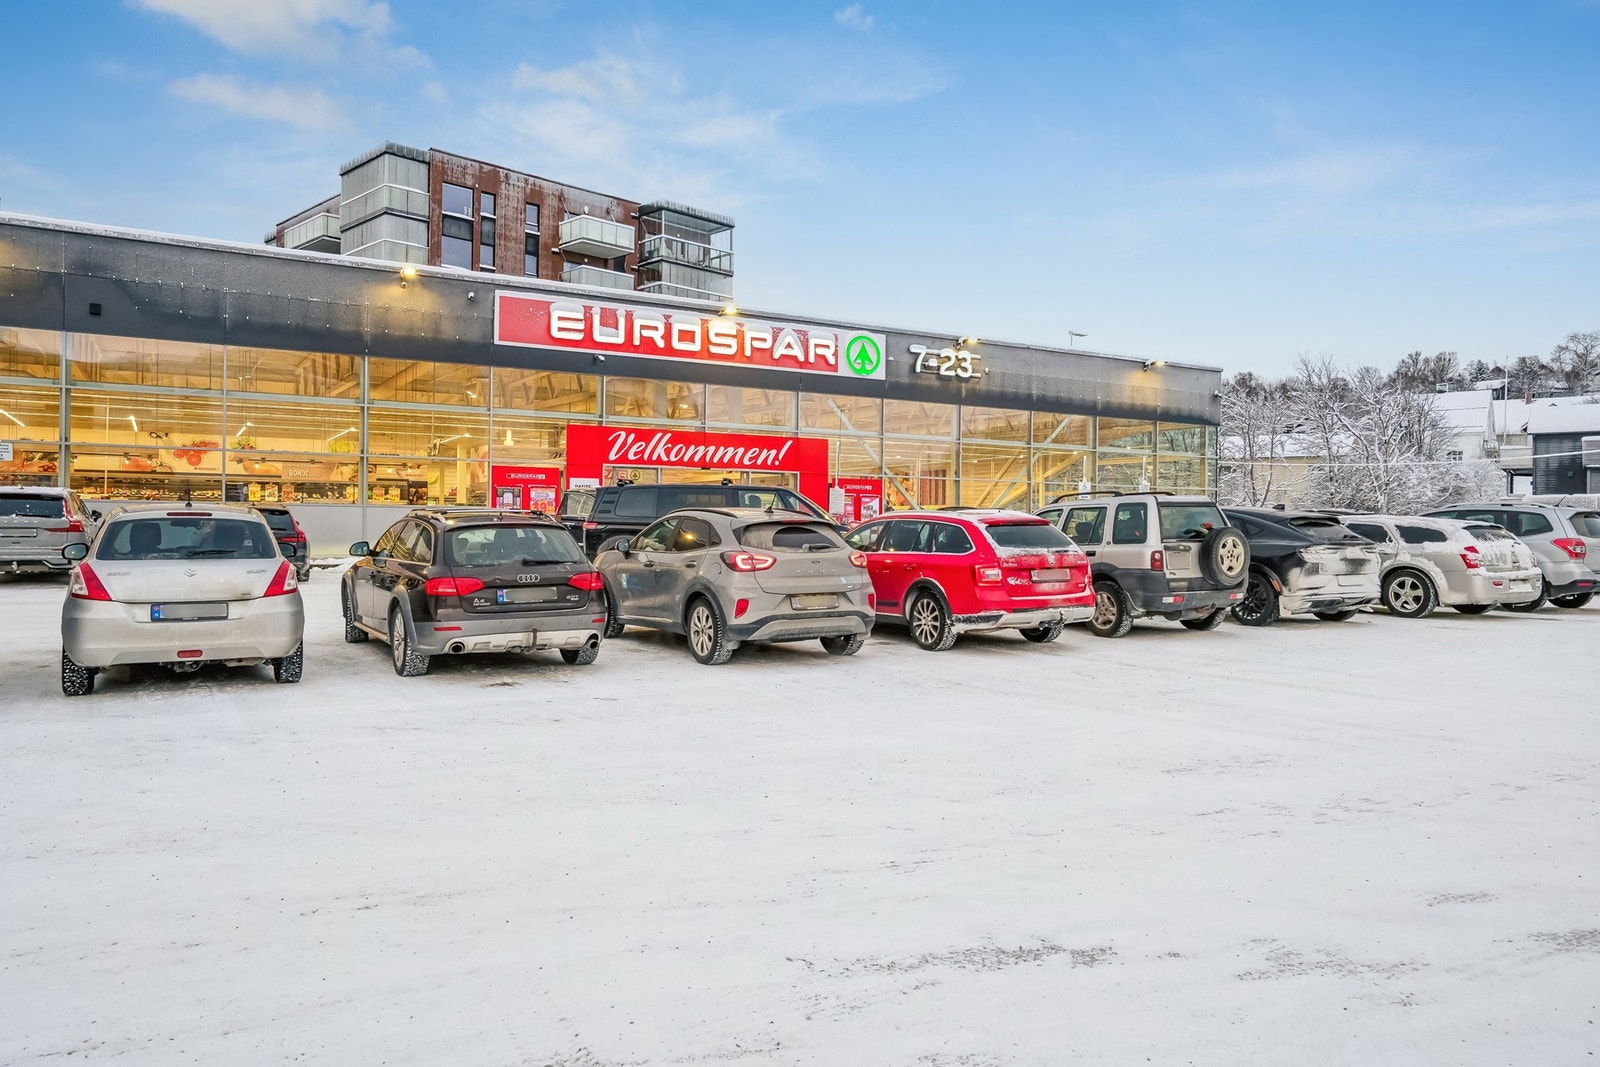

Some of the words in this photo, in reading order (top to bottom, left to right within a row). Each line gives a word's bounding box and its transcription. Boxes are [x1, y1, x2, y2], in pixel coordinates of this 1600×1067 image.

[549, 304, 838, 366] EUROSPAR
[909, 344, 973, 378] 7-23
[608, 430, 793, 466] Velkommen!
